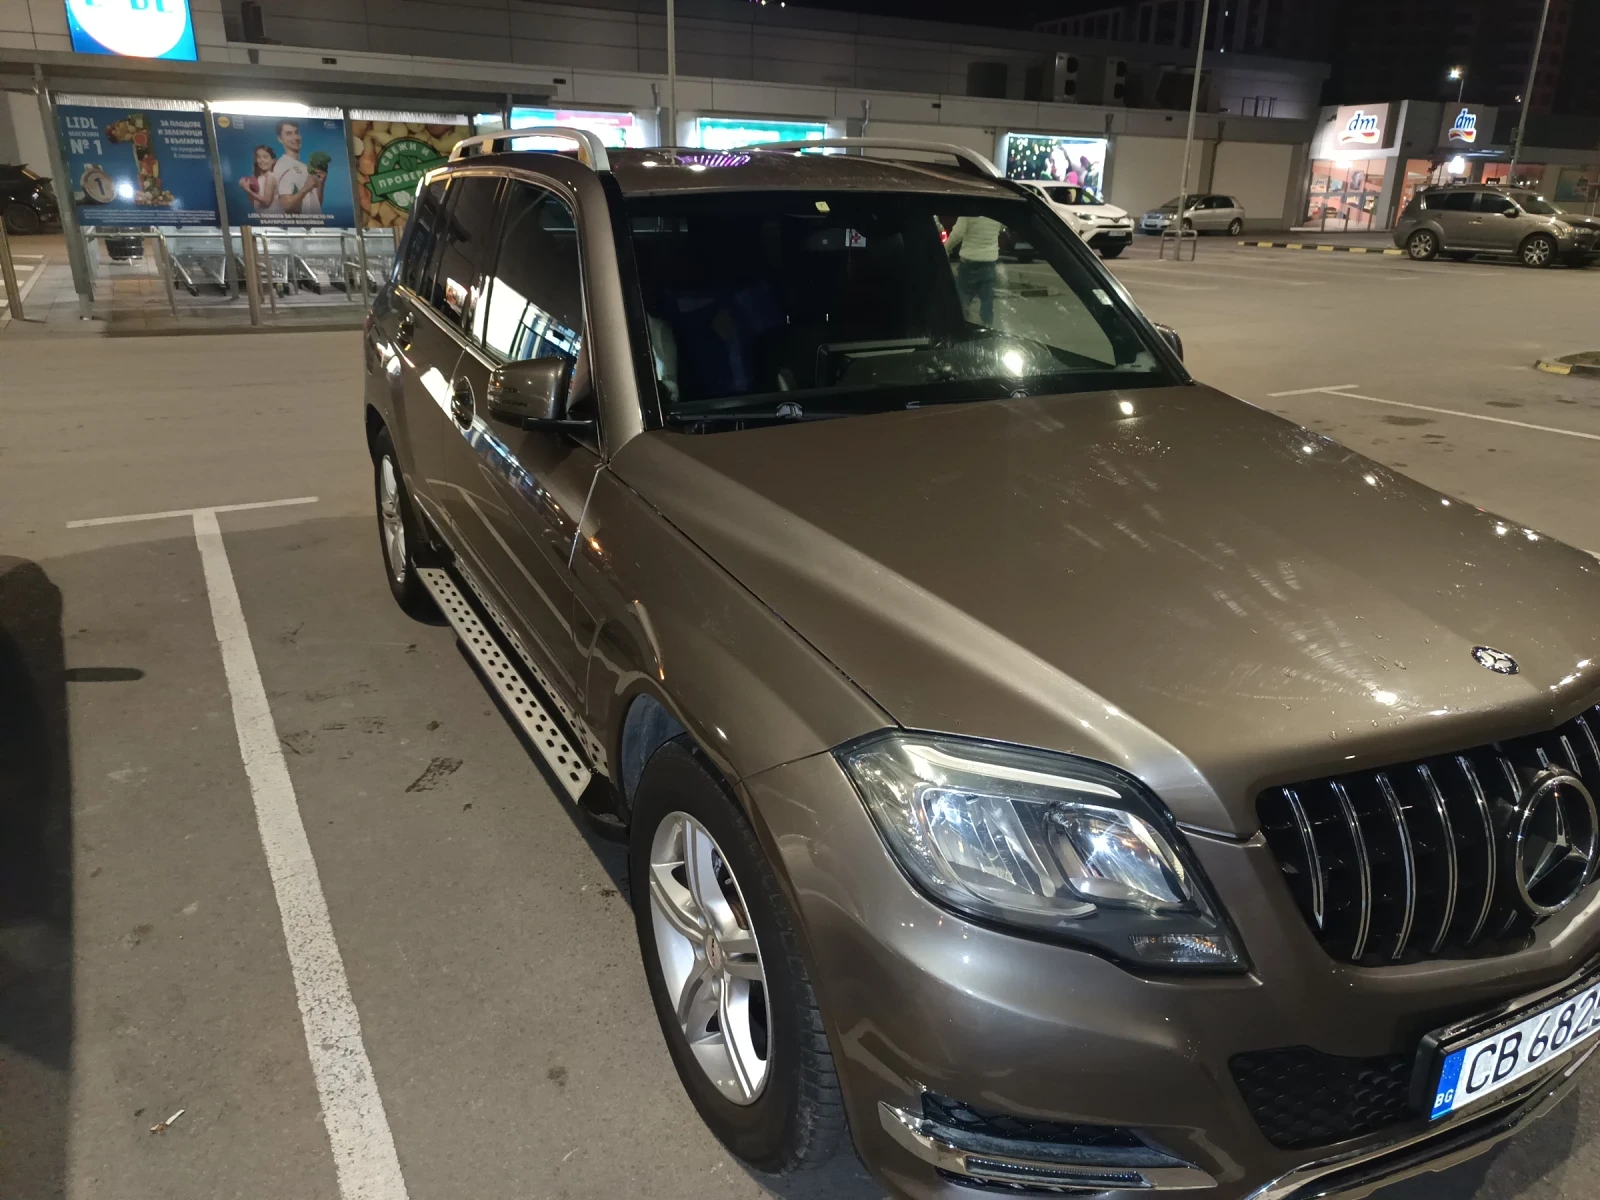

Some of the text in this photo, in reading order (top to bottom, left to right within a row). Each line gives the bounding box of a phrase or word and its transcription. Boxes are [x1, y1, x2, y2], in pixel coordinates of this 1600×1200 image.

[65, 116, 99, 129] LIDL
[170, 120, 202, 128] ПЛОДОВЕ
[1349, 113, 1376, 131] dm
[1456, 110, 1475, 130] dm
[164, 129, 203, 137] ЗЕЛЕНЧУЦИ
[93, 139, 103, 155] 1
[381, 142, 430, 167] СВЕЖИ И
[94, 177, 105, 196] 1
[1466, 1031, 1523, 1094] CB
[1434, 1089, 1454, 1108] BG
